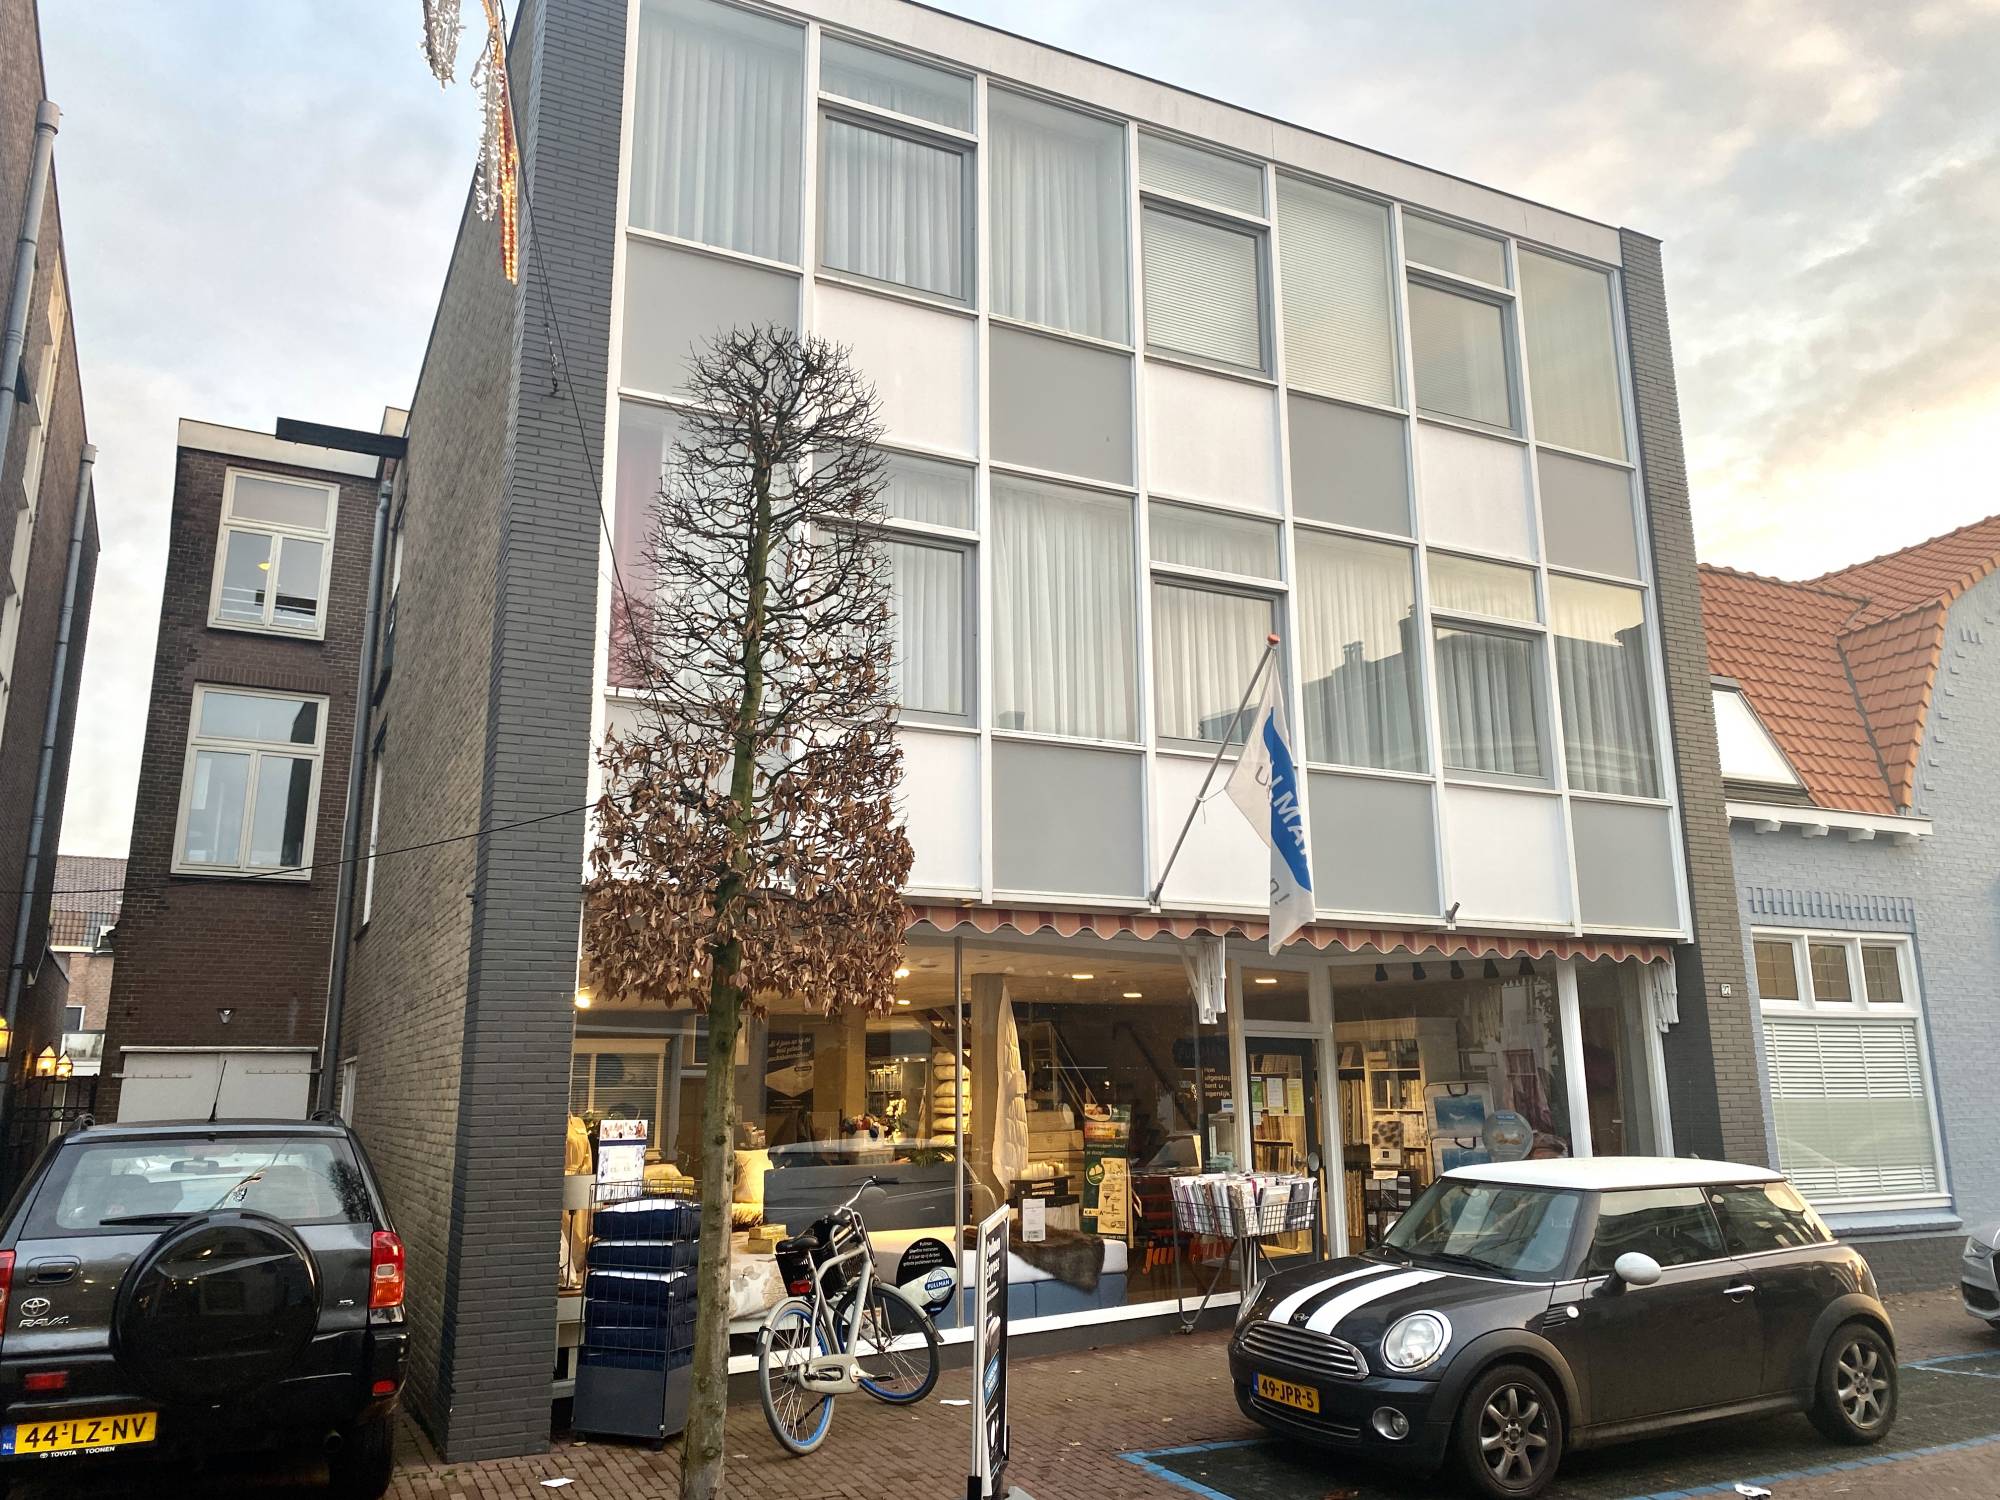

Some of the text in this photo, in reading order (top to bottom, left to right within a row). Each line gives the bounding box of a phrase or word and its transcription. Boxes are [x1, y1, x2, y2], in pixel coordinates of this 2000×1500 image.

[927, 1279, 950, 1290] PULLMAN
[1262, 1378, 1314, 1409] 49-JPR-5
[24, 1416, 148, 1449] 44-LZ-NV
[51, 1446, 115, 1458] TOYOTA TOONEN
